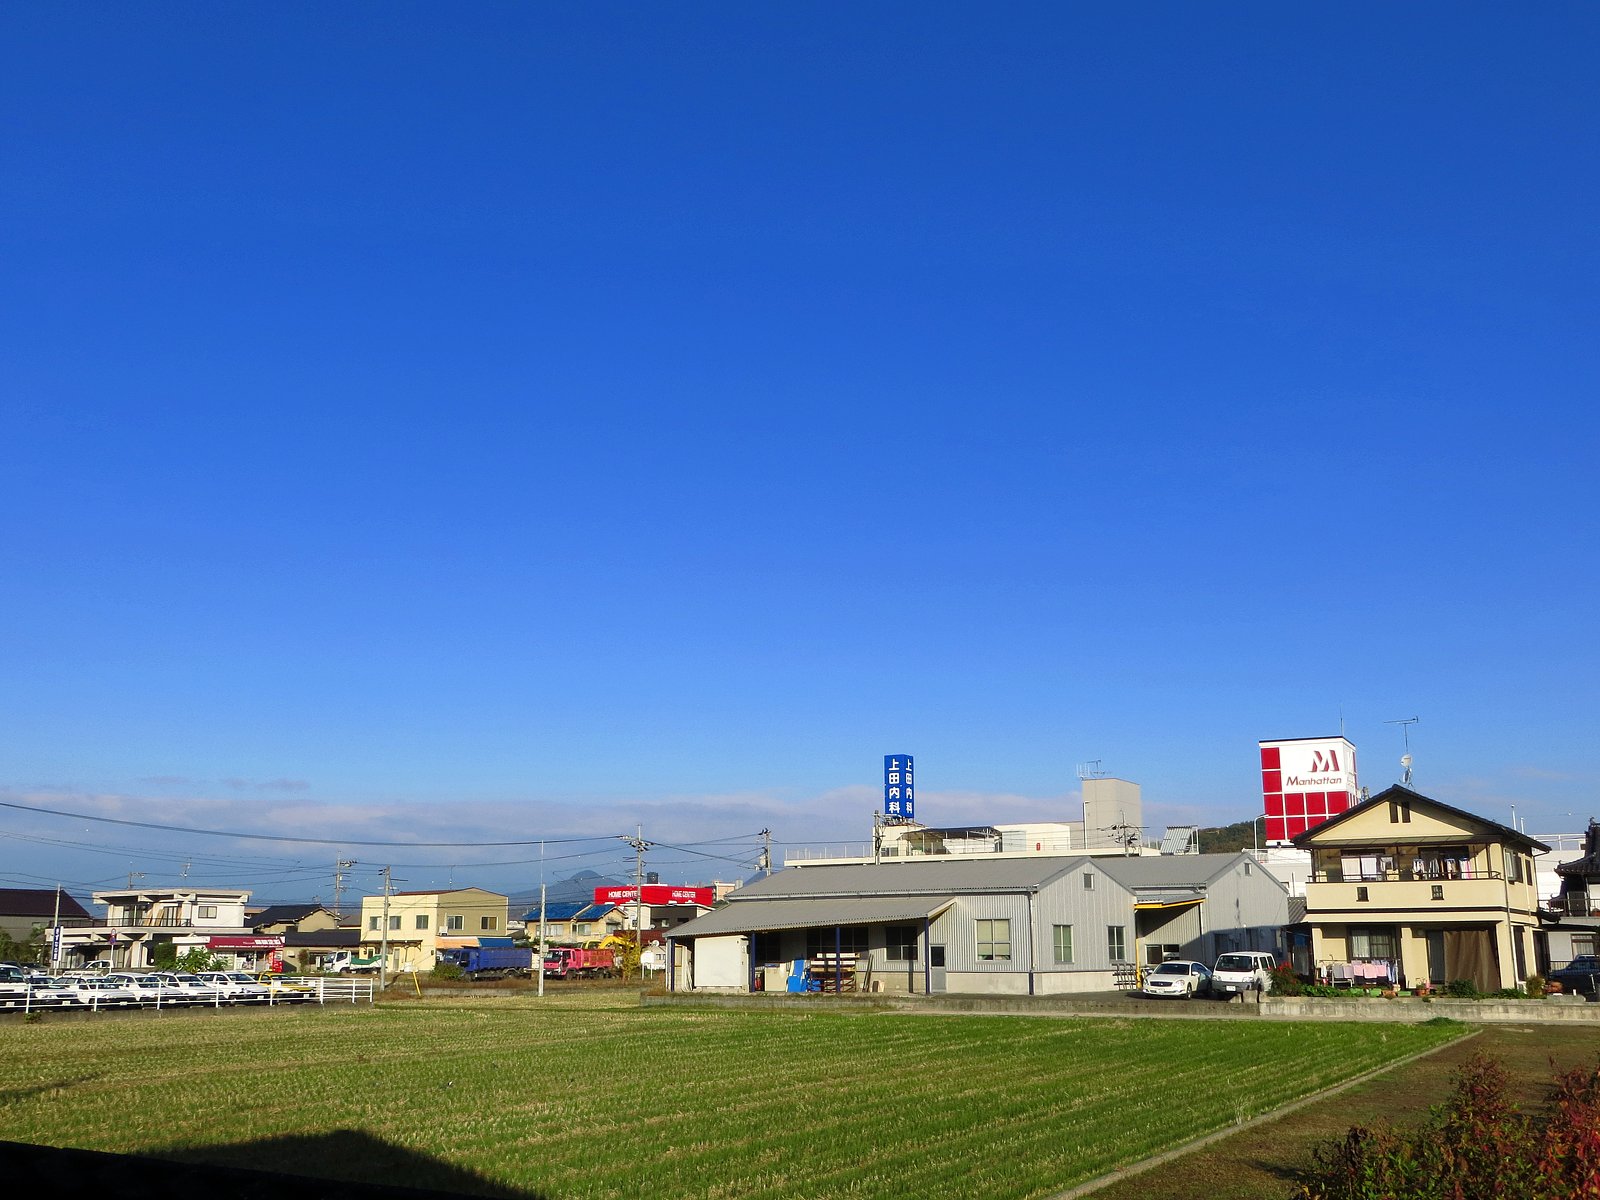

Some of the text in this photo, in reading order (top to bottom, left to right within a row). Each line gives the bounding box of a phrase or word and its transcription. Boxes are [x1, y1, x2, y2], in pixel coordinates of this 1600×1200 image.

[888, 758, 901, 814] 上田内科
[1286, 776, 1342, 787] Manhattan
[608, 890, 640, 898] HOME CENTE
[672, 890, 682, 898] HOME
